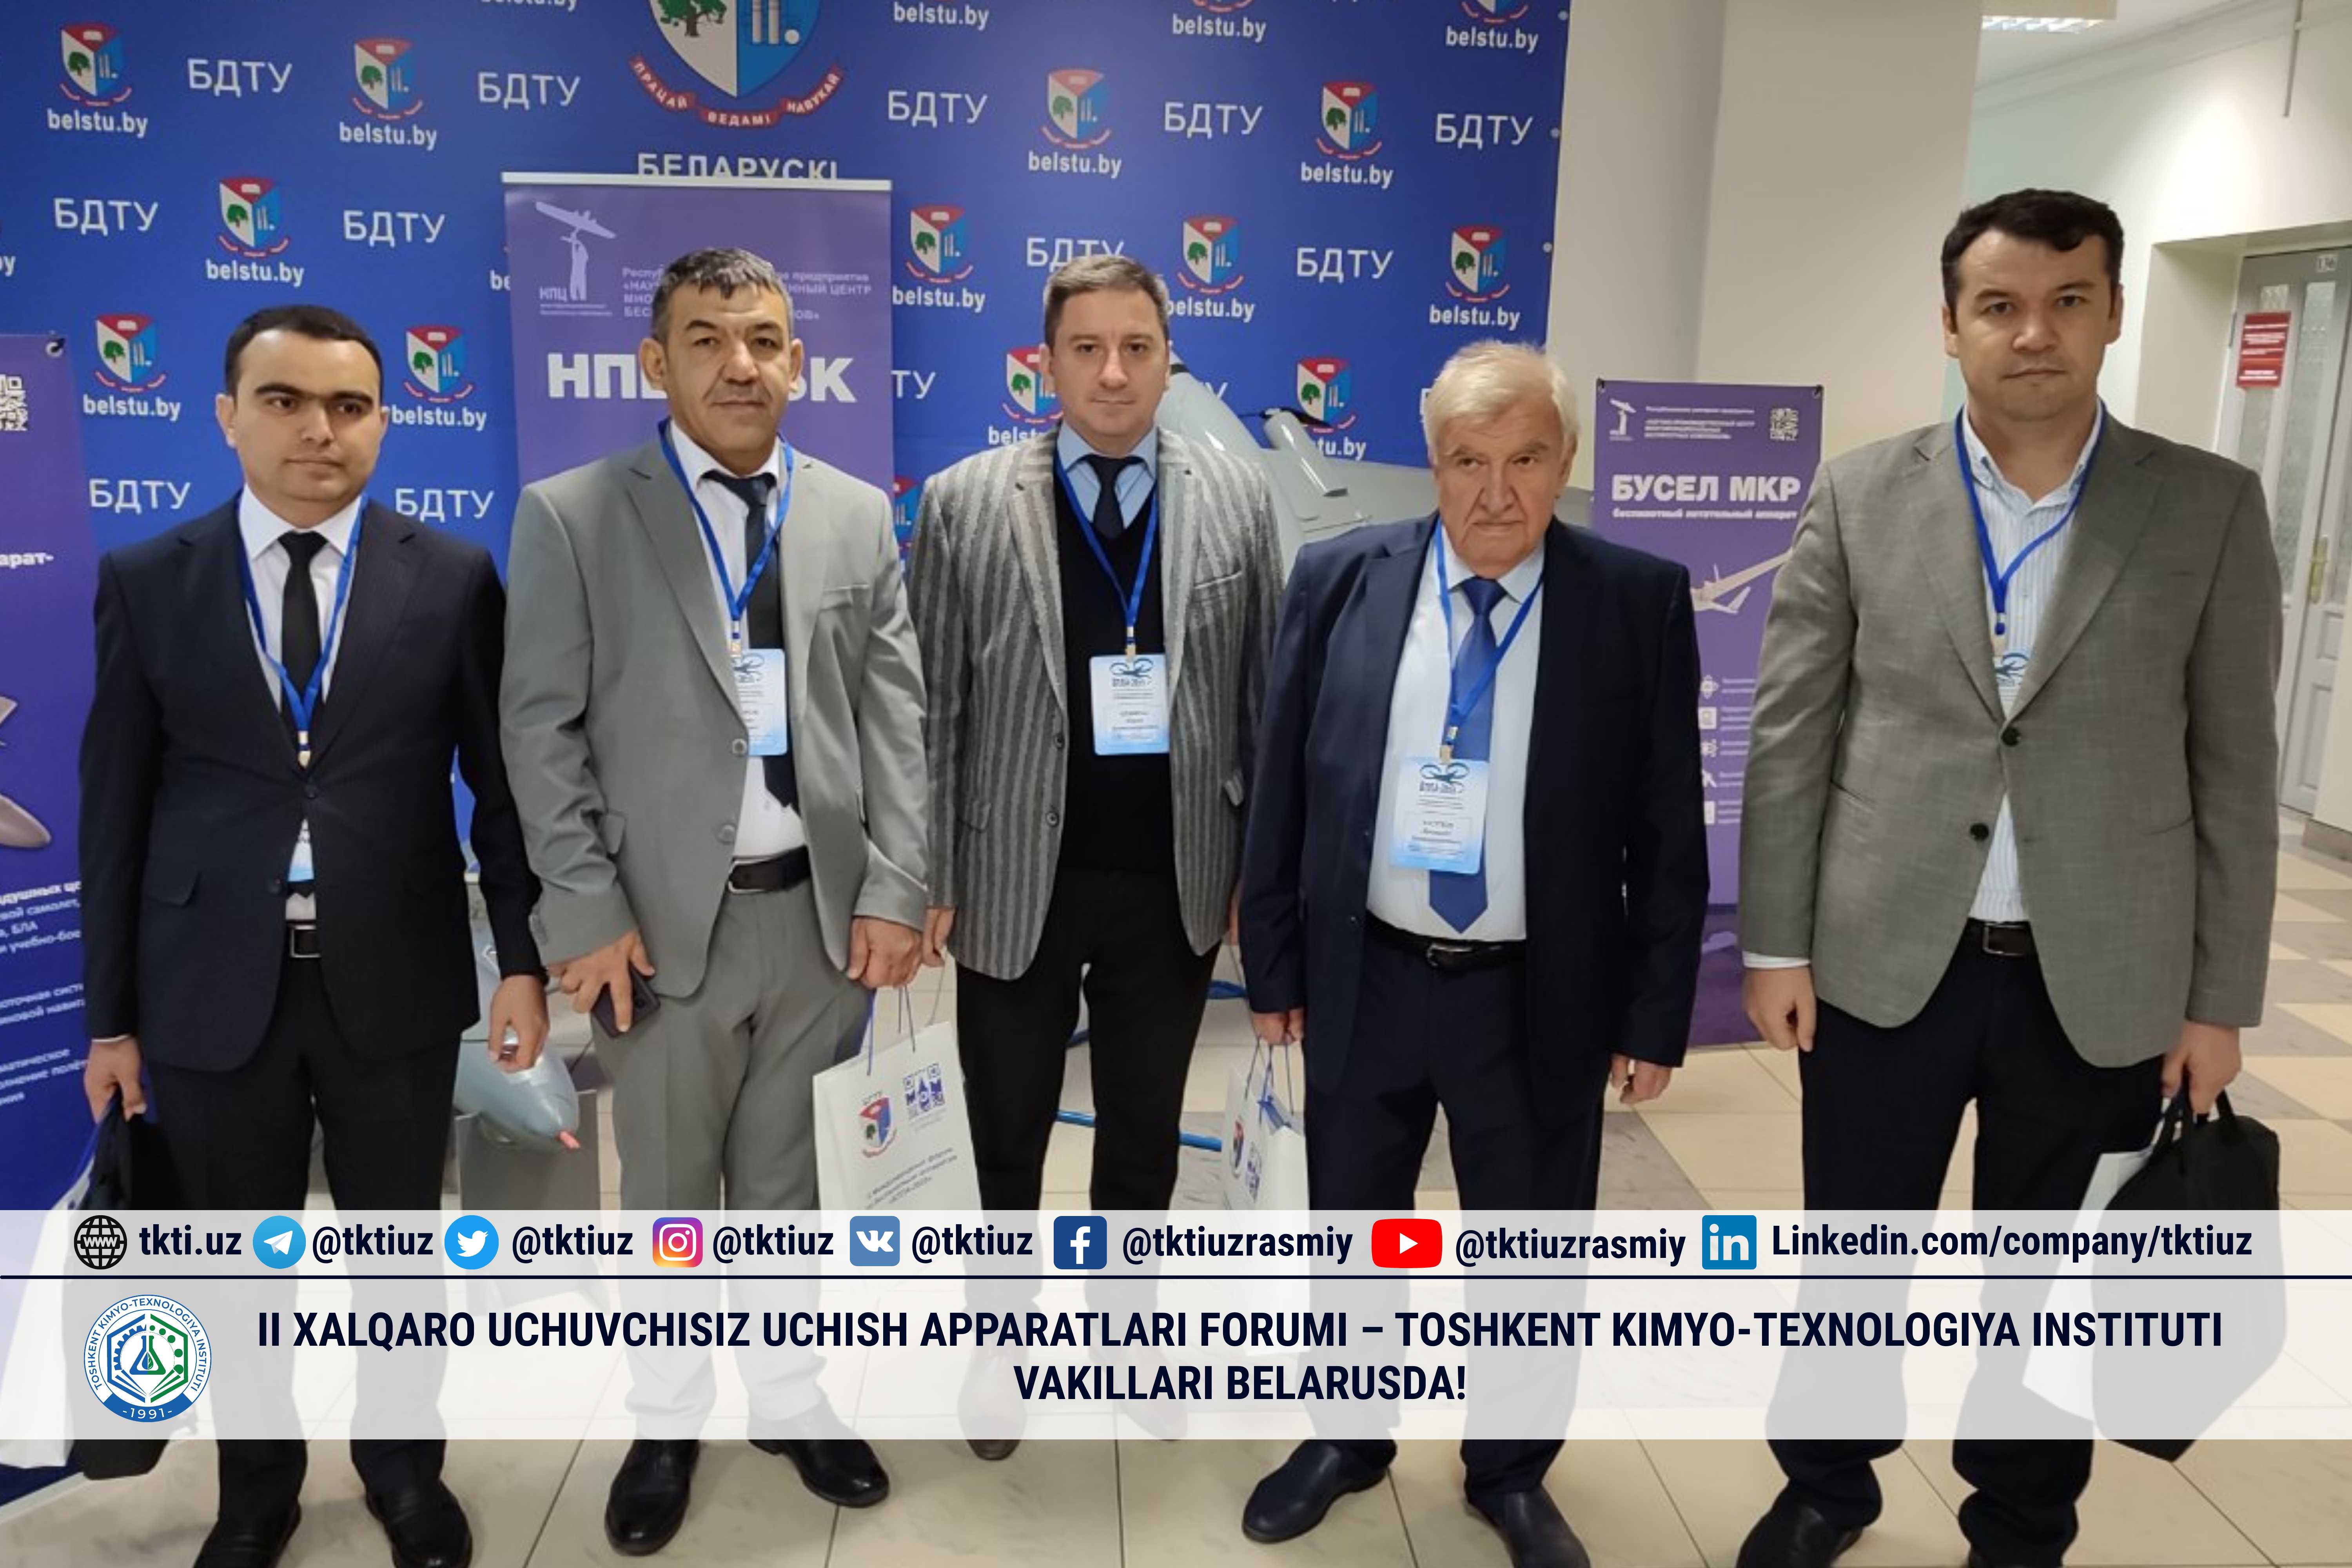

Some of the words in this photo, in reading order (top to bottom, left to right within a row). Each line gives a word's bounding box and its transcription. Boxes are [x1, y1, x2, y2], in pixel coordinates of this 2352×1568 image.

[894, 2, 989, 31] belstu.by
[1172, 13, 1267, 43] belstu.by
[1446, 26, 1538, 54] belstu.by
[187, 58, 292, 97] БДТУ
[477, 73, 580, 110] БДТУ
[47, 109, 148, 138] belstu.by
[888, 91, 988, 127] БДТУ
[1164, 102, 1263, 139] БДТУ
[339, 122, 437, 150] belstu.by
[1435, 113, 1533, 149] БДТУ
[1028, 151, 1122, 179] belstu.by
[1301, 162, 1394, 190] belstu.by
[53, 198, 158, 235] БДТУ
[343, 211, 445, 247] БДТУ
[206, 259, 304, 287] belstu.by
[1296, 247, 1394, 283] БДТУ
[892, 285, 985, 312] belstu.by
[1429, 305, 1521, 331] belstu.by
[83, 395, 181, 421] belstu.by
[392, 404, 487, 431] belstu.by
[89, 478, 191, 514] БДТУ
[1612, 474, 1718, 502] БУСЕЛ
[1729, 475, 1801, 502] МКР
[395, 488, 494, 523] БДТУ
